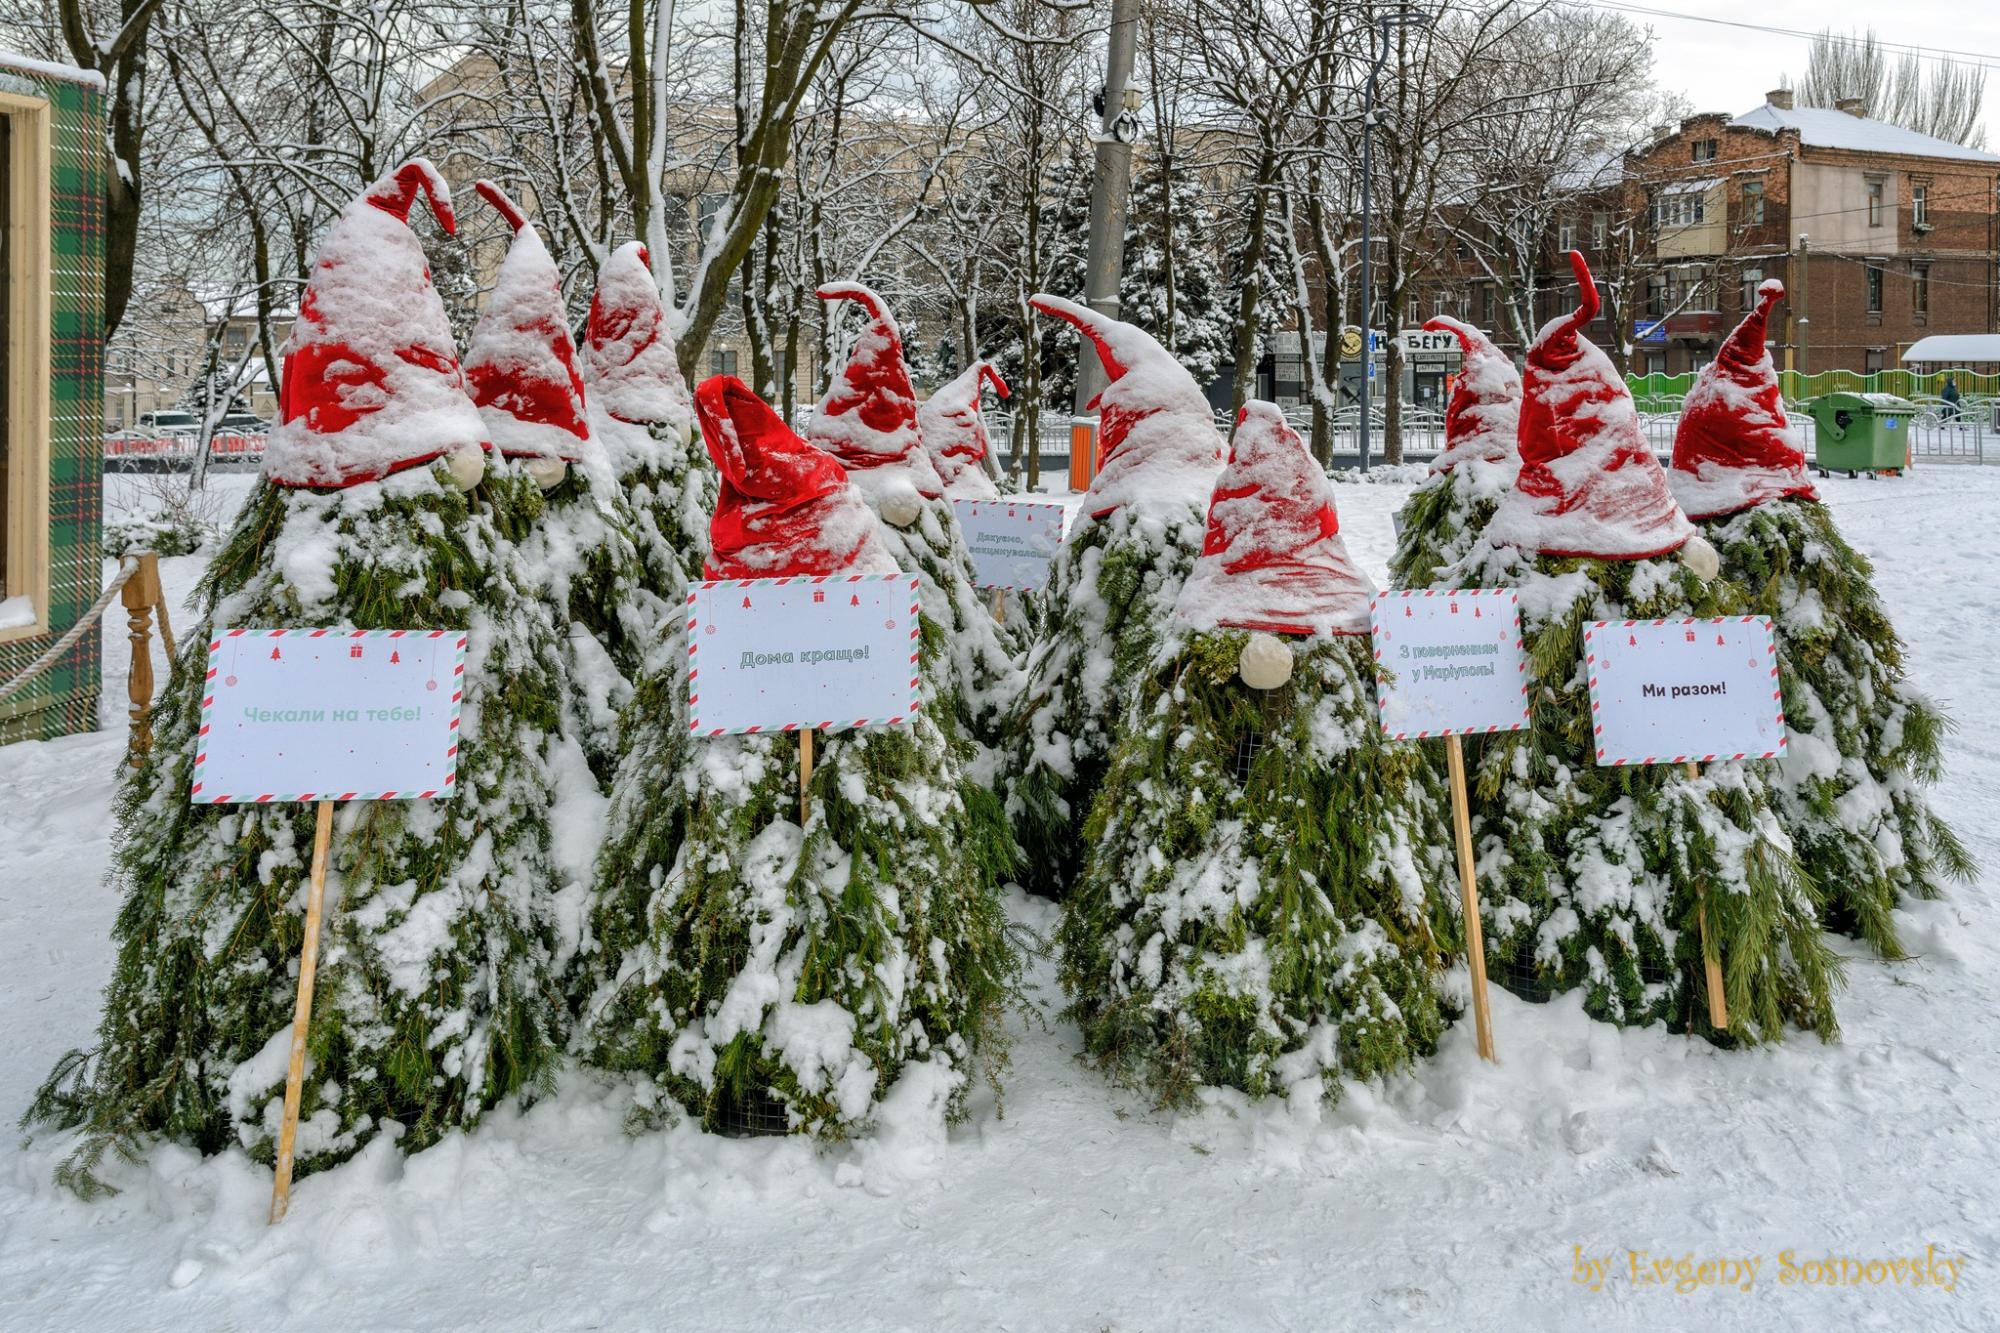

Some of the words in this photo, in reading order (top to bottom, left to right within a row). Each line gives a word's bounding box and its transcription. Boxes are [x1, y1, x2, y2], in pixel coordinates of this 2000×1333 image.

[740, 651, 794, 669] Дома
[800, 645, 870, 665] краще!
[1399, 644, 1410, 659] З
[1412, 642, 1499, 660] поверненням
[1411, 668, 1421, 683] у
[1422, 661, 1495, 683] Маріуполь!
[1642, 684, 1665, 698] Ми
[1671, 681, 1727, 699] разом!
[244, 706, 324, 722] Чекали
[332, 708, 359, 722] на
[366, 705, 421, 722] тебе!
